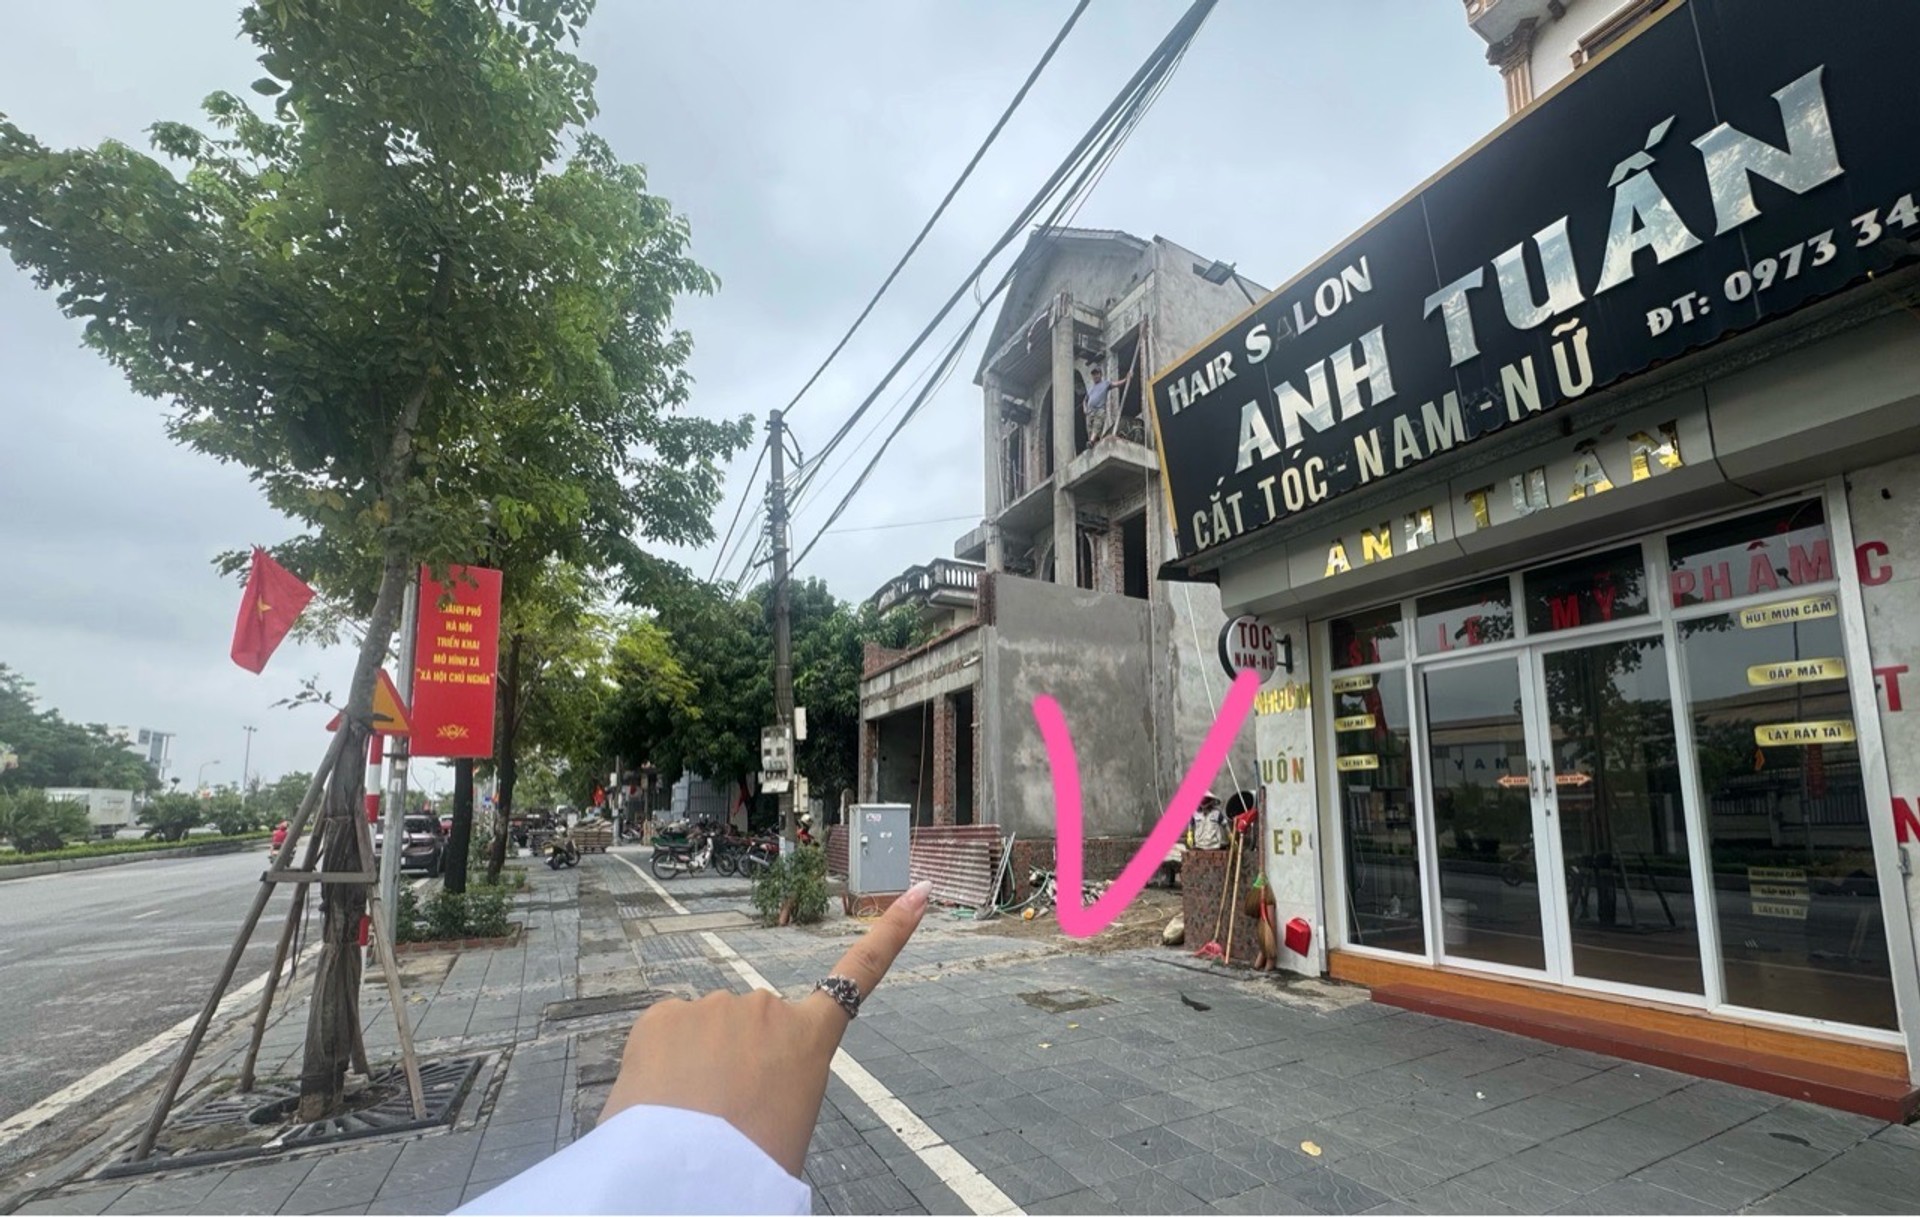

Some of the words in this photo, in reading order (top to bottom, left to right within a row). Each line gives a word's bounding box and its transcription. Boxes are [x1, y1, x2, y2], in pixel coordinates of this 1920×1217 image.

[1235, 324, 1397, 474] ANH
[1423, 64, 1845, 367] TUẤN
[1646, 291, 1711, 337] ĐT:
[1724, 228, 1837, 301] 0973
[1168, 351, 1237, 415] HAIR
[1192, 477, 1244, 549] CẮT
[1324, 505, 1437, 577] ANH
[1237, 615, 1272, 651] TÓC
[1262, 747, 1305, 783] UỐN
